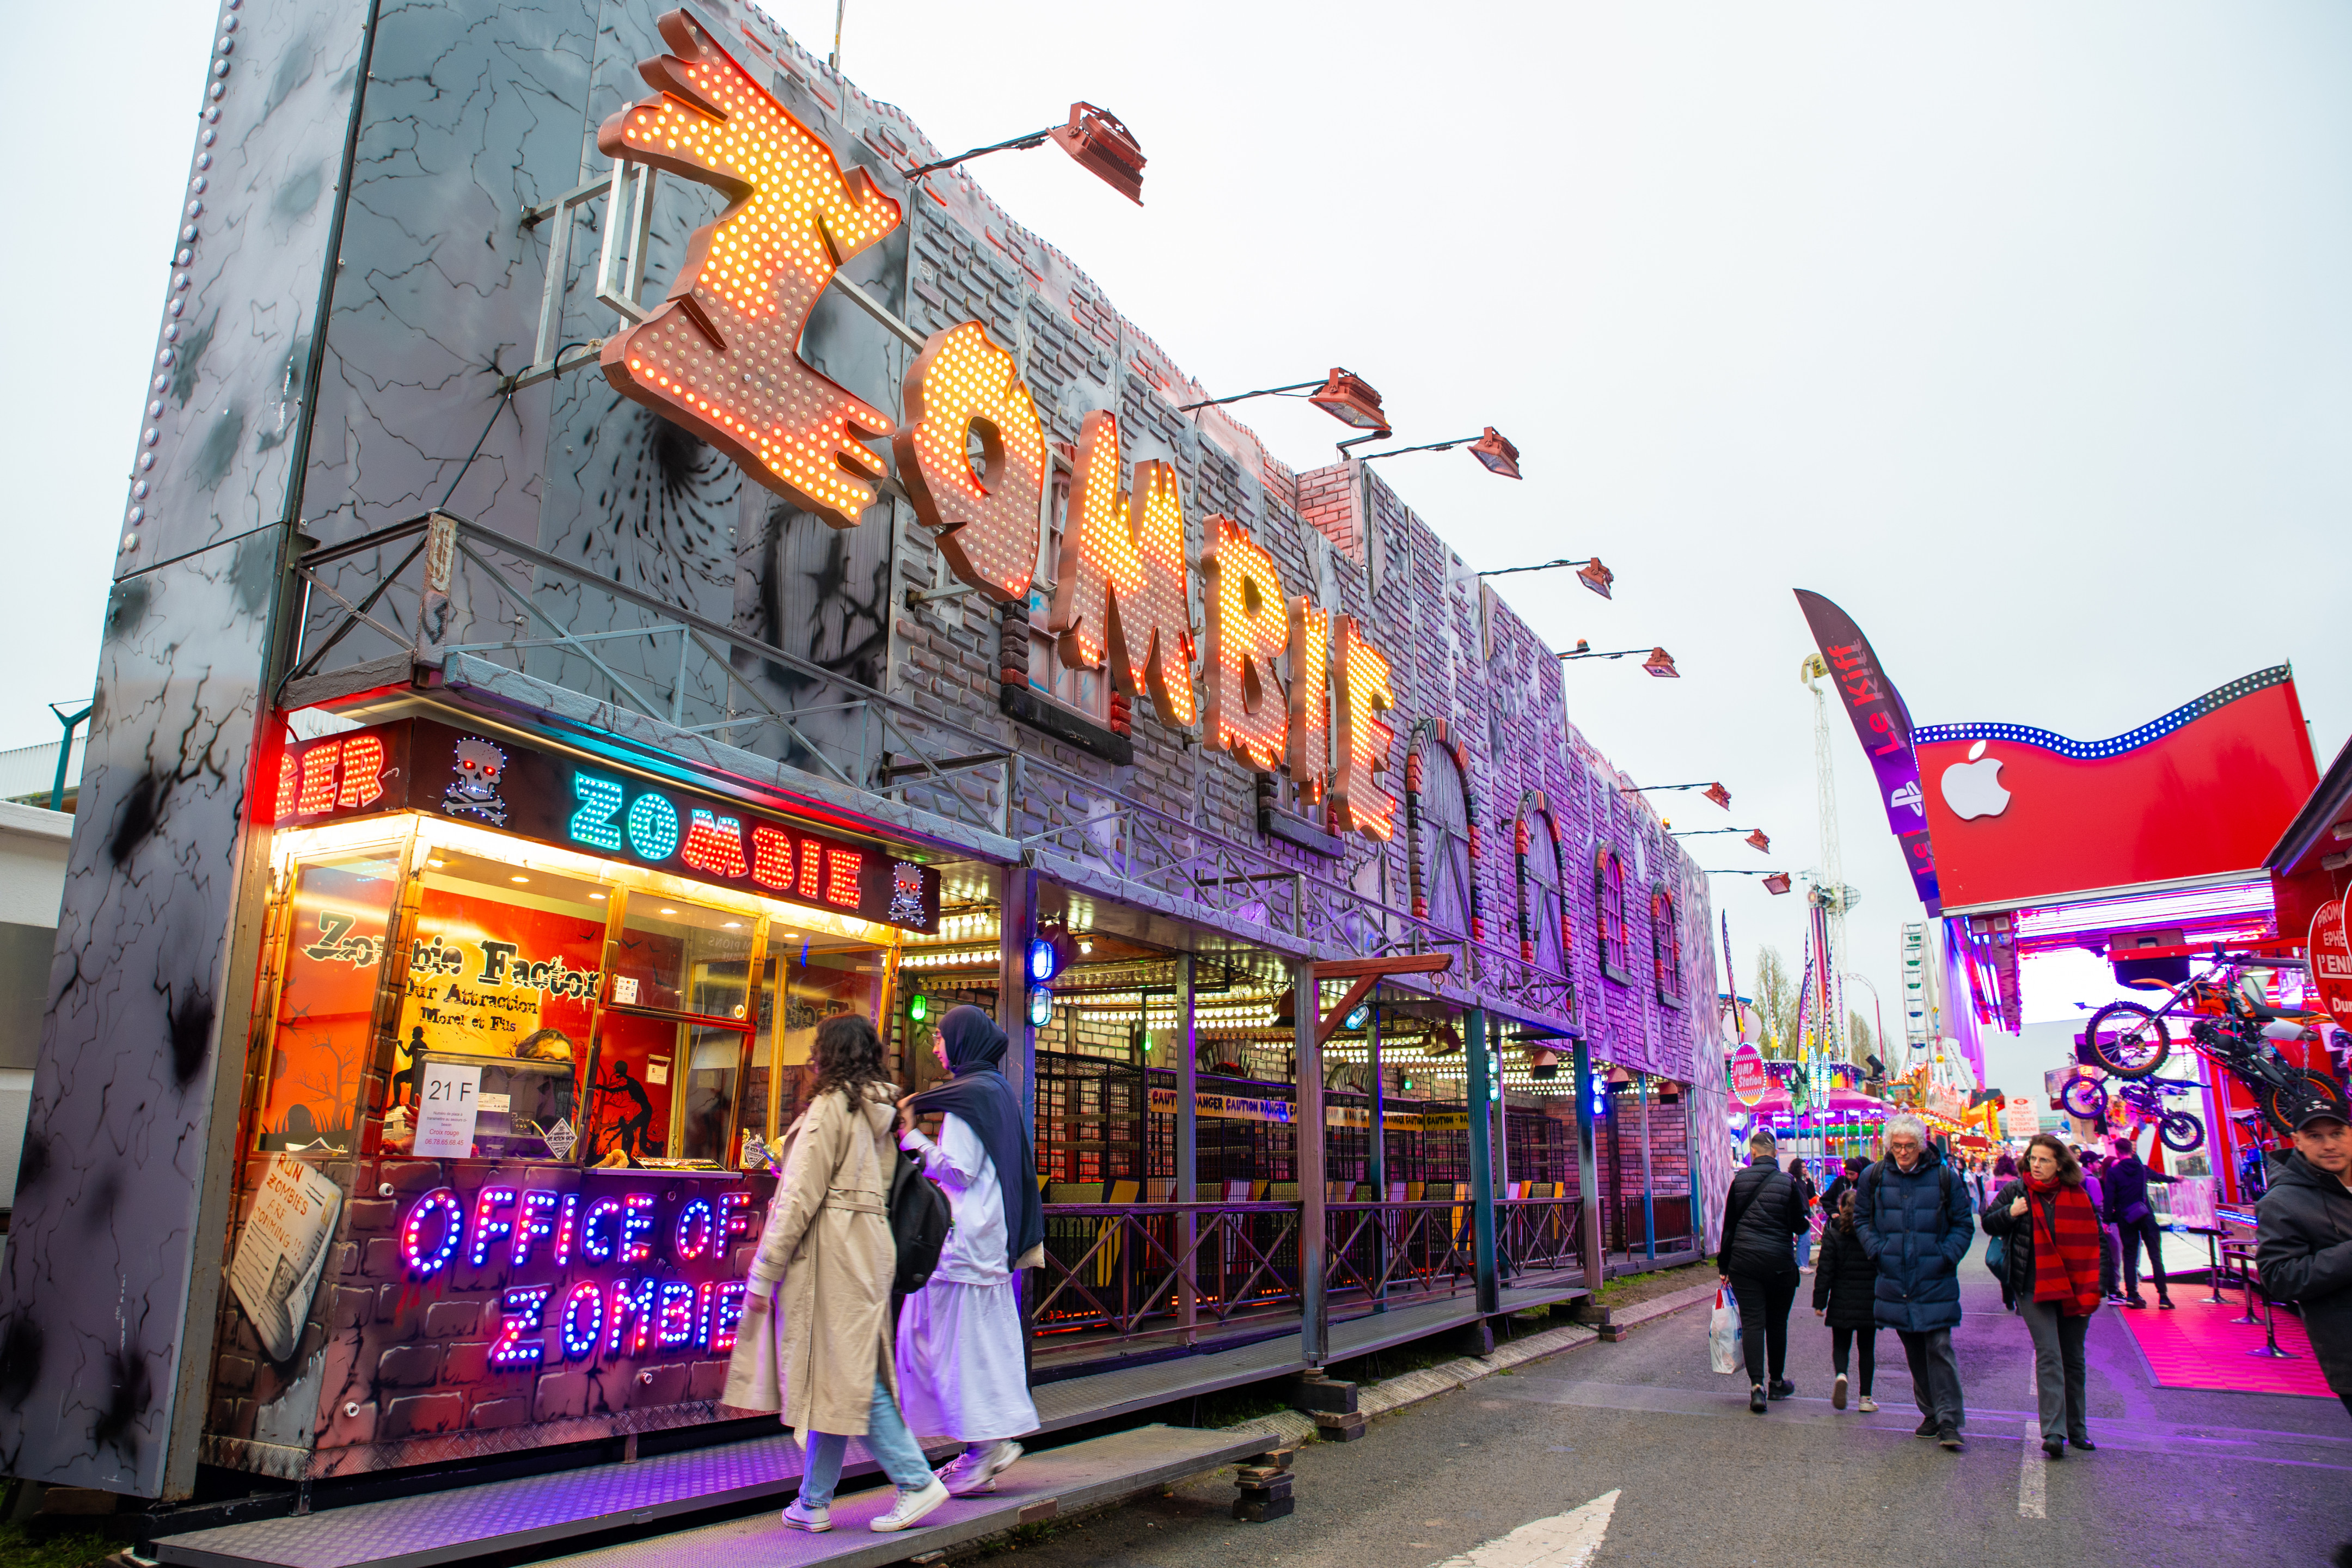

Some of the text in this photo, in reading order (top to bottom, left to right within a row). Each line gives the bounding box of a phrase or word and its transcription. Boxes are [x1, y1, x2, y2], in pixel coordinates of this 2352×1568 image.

[598, 8, 1396, 842] ZOMBIE
[1827, 645, 1900, 756] Le Kiff
[571, 770, 862, 909] ZOMBIE
[443, 983, 538, 1014] Attraction
[420, 1007, 516, 1032] Morel et Fils
[1734, 1062, 1754, 1076] JUMP
[1738, 1075, 1762, 1088] Station
[428, 1080, 473, 1101] 21 F
[1152, 1091, 1177, 1111] CAUT
[1226, 1097, 1258, 1116] CAUTION
[1260, 1100, 1287, 1118] DANGER
[1406, 1116, 1423, 1126] CAUTION
[1427, 1116, 1454, 1125] CAUTION
[277, 1153, 304, 1183] RUN
[267, 1173, 309, 1216] ZOMBIES
[267, 1199, 287, 1222] ARE
[253, 1206, 291, 1248] COMMING
[402, 1185, 751, 1277] OFFICE OF
[489, 1278, 745, 1365] ZOMBIE
